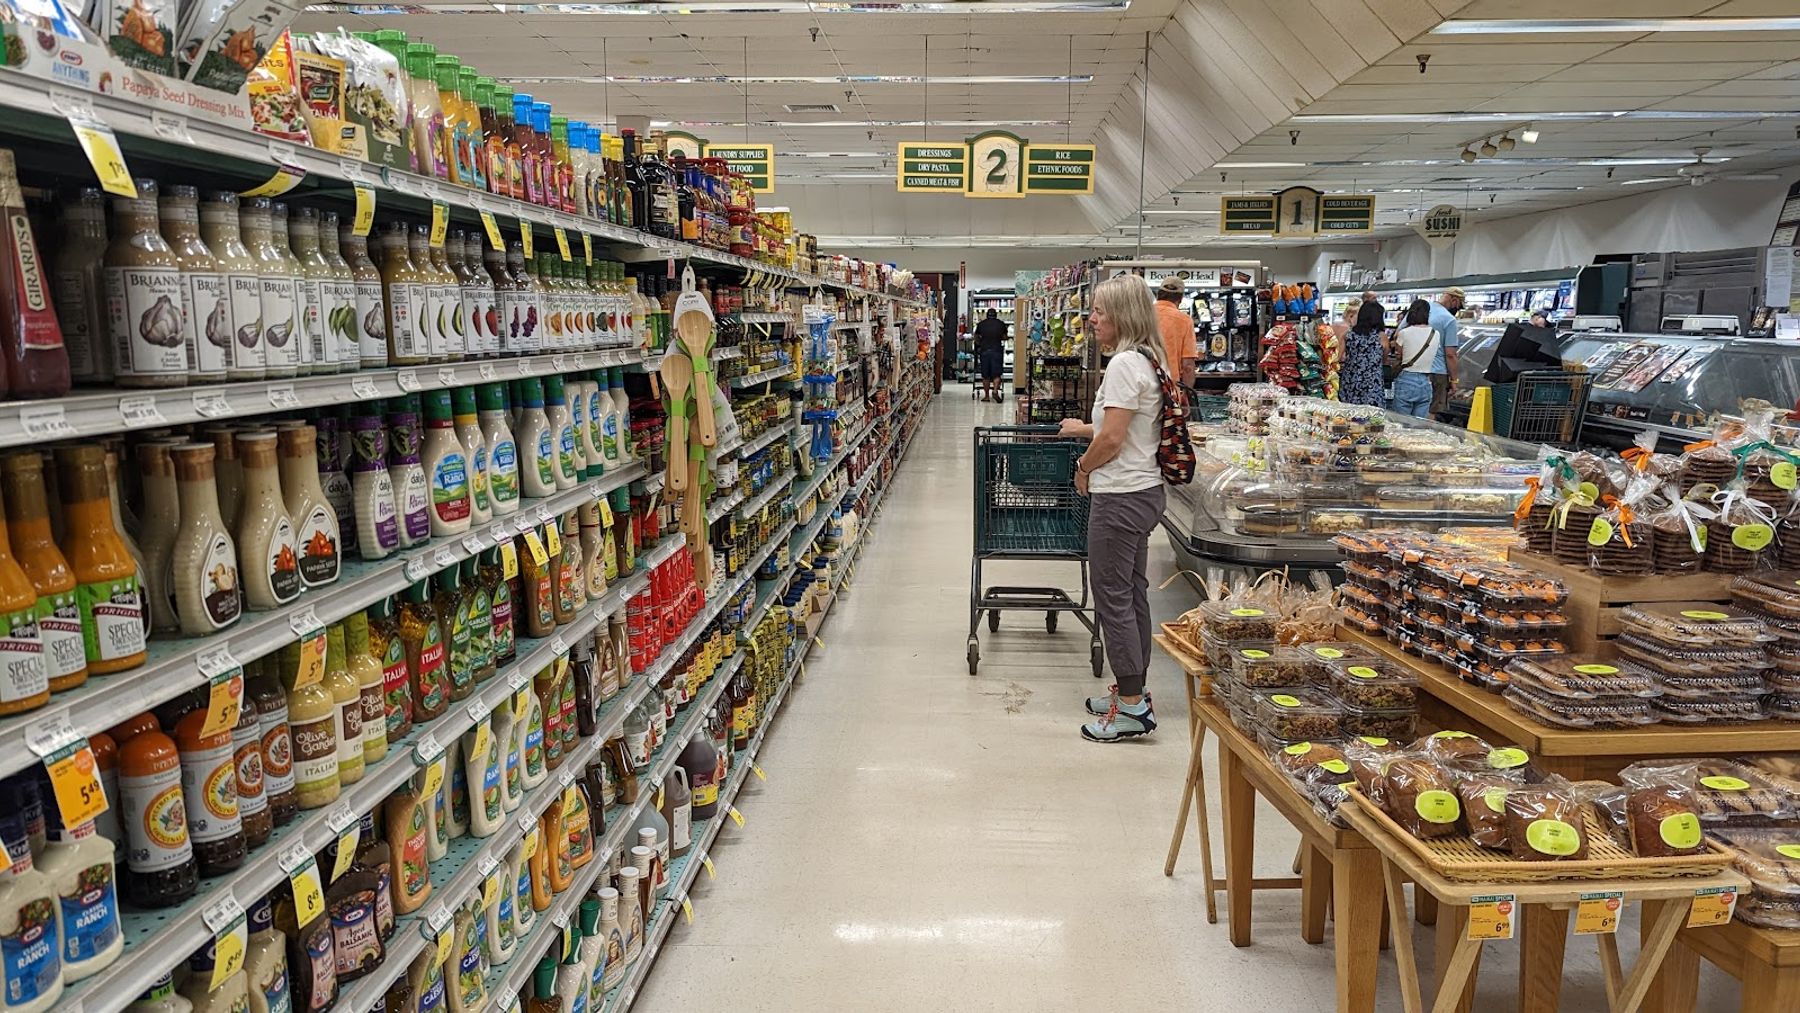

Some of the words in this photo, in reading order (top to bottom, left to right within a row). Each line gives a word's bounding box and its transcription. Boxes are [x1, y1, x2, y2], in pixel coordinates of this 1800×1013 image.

[122, 76, 160, 99] Papaya
[161, 87, 185, 105] Seed
[187, 94, 227, 116] Dressing
[228, 104, 246, 120] Mix
[712, 150, 738, 159] LAUNDRY
[738, 150, 765, 159] SUPPLIES
[917, 149, 952, 157] DRESSINGS
[1055, 151, 1071, 160] RICE
[736, 164, 754, 173] FOOD
[917, 163, 931, 172] DRY
[931, 163, 950, 172] PASTA
[986, 148, 1007, 182] 2
[1037, 165, 1062, 174] ETHNIC
[1061, 165, 1083, 174] FOODS
[906, 177, 929, 186] CANNED
[929, 178, 943, 186] MEAT
[948, 178, 960, 187] FISH
[1293, 199, 1304, 226] 1
[1425, 217, 1460, 230] SUSHI
[17, 229, 42, 307] GIRARD'S
[1190, 271, 1214, 280] Head
[444, 473, 465, 484] Ranch
[295, 730, 328, 745] Olive
[75, 906, 108, 928] RANCH
[340, 929, 373, 948] BALSAMIC
[17, 944, 49, 969] RANCH
